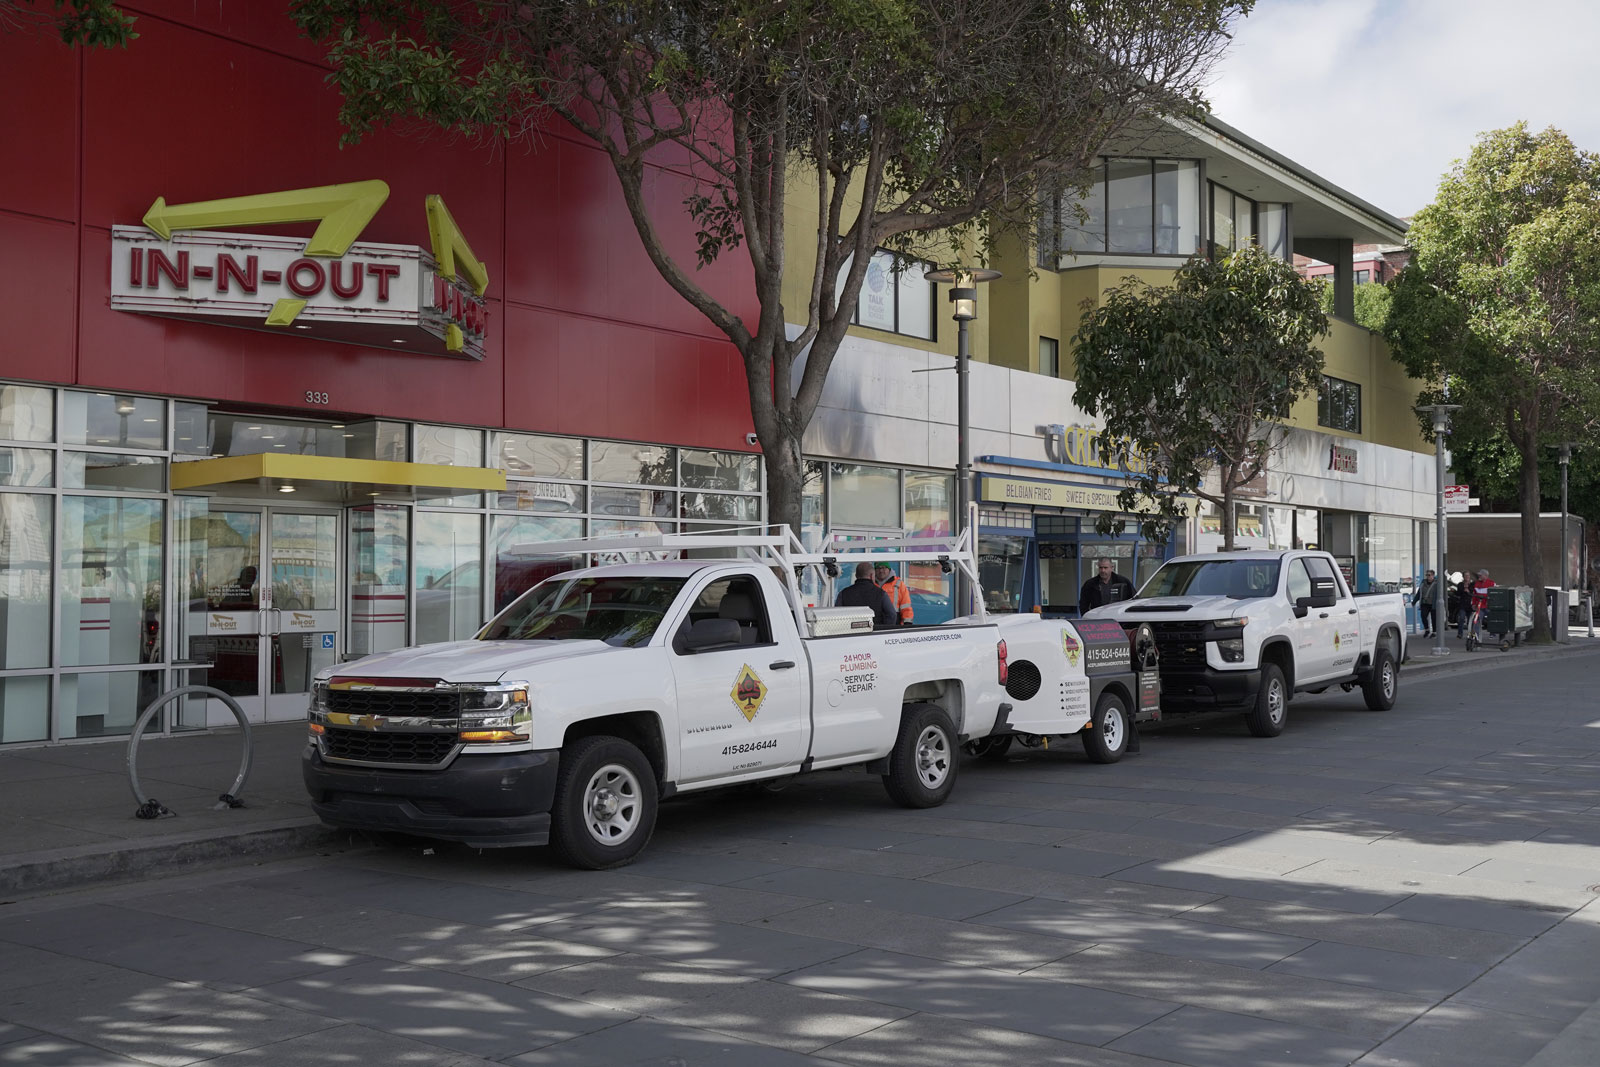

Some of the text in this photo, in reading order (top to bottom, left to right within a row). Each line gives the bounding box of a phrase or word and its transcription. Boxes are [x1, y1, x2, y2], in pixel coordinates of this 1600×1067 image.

[130, 247, 400, 302] IN-N-OUT
[305, 391, 329, 405] 333
[1006, 484, 1052, 501] BELGIAN FRIES
[1066, 490, 1086, 504] SWEET
[843, 653, 872, 663] 24 HOUR
[1087, 647, 1130, 660] 415-824-6444
[840, 661, 878, 672] PLUMBING
[844, 673, 875, 684] SERVICE
[737, 679, 760, 695] ACE
[847, 683, 873, 693] REPAIR
[722, 739, 777, 756] 415-824-6444
